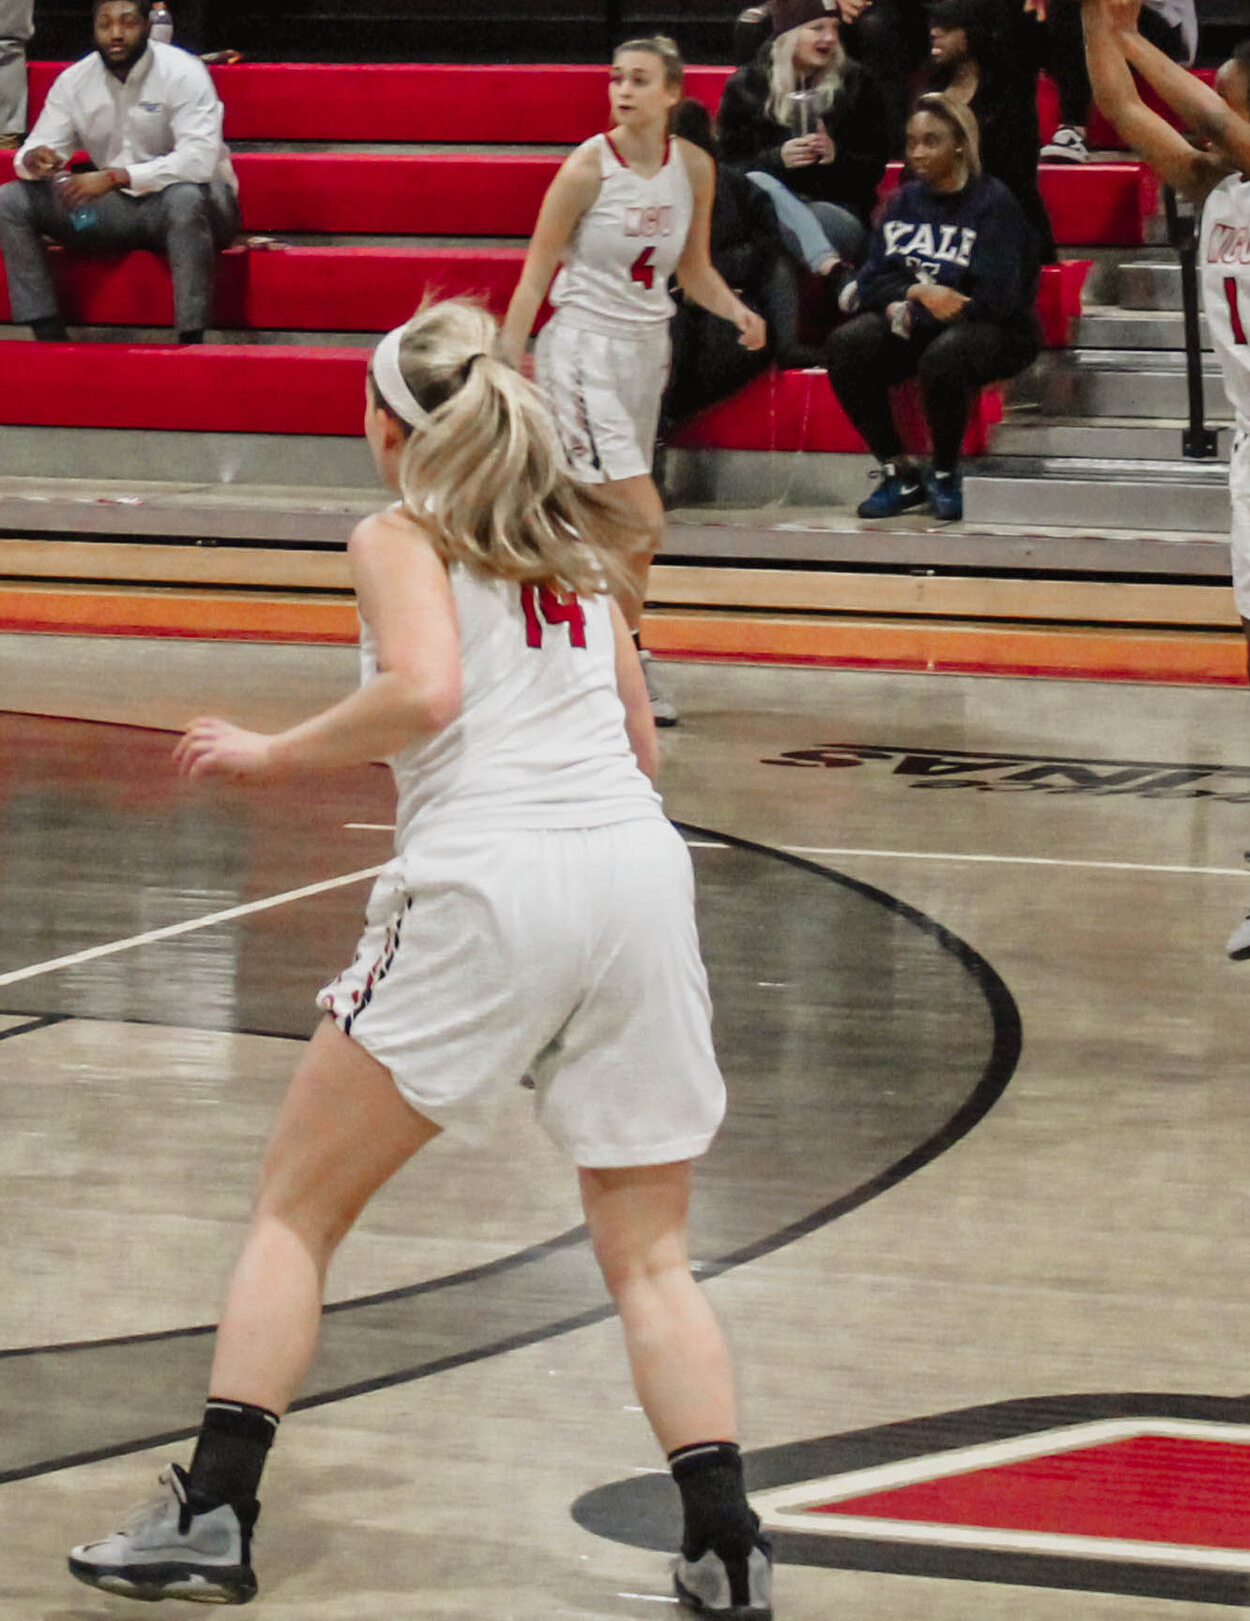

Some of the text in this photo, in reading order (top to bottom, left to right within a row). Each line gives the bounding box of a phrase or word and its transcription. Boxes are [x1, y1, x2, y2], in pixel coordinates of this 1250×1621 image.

[630, 246, 656, 289] 4
[1223, 277, 1247, 344] 1
[521, 582, 586, 649] 14
